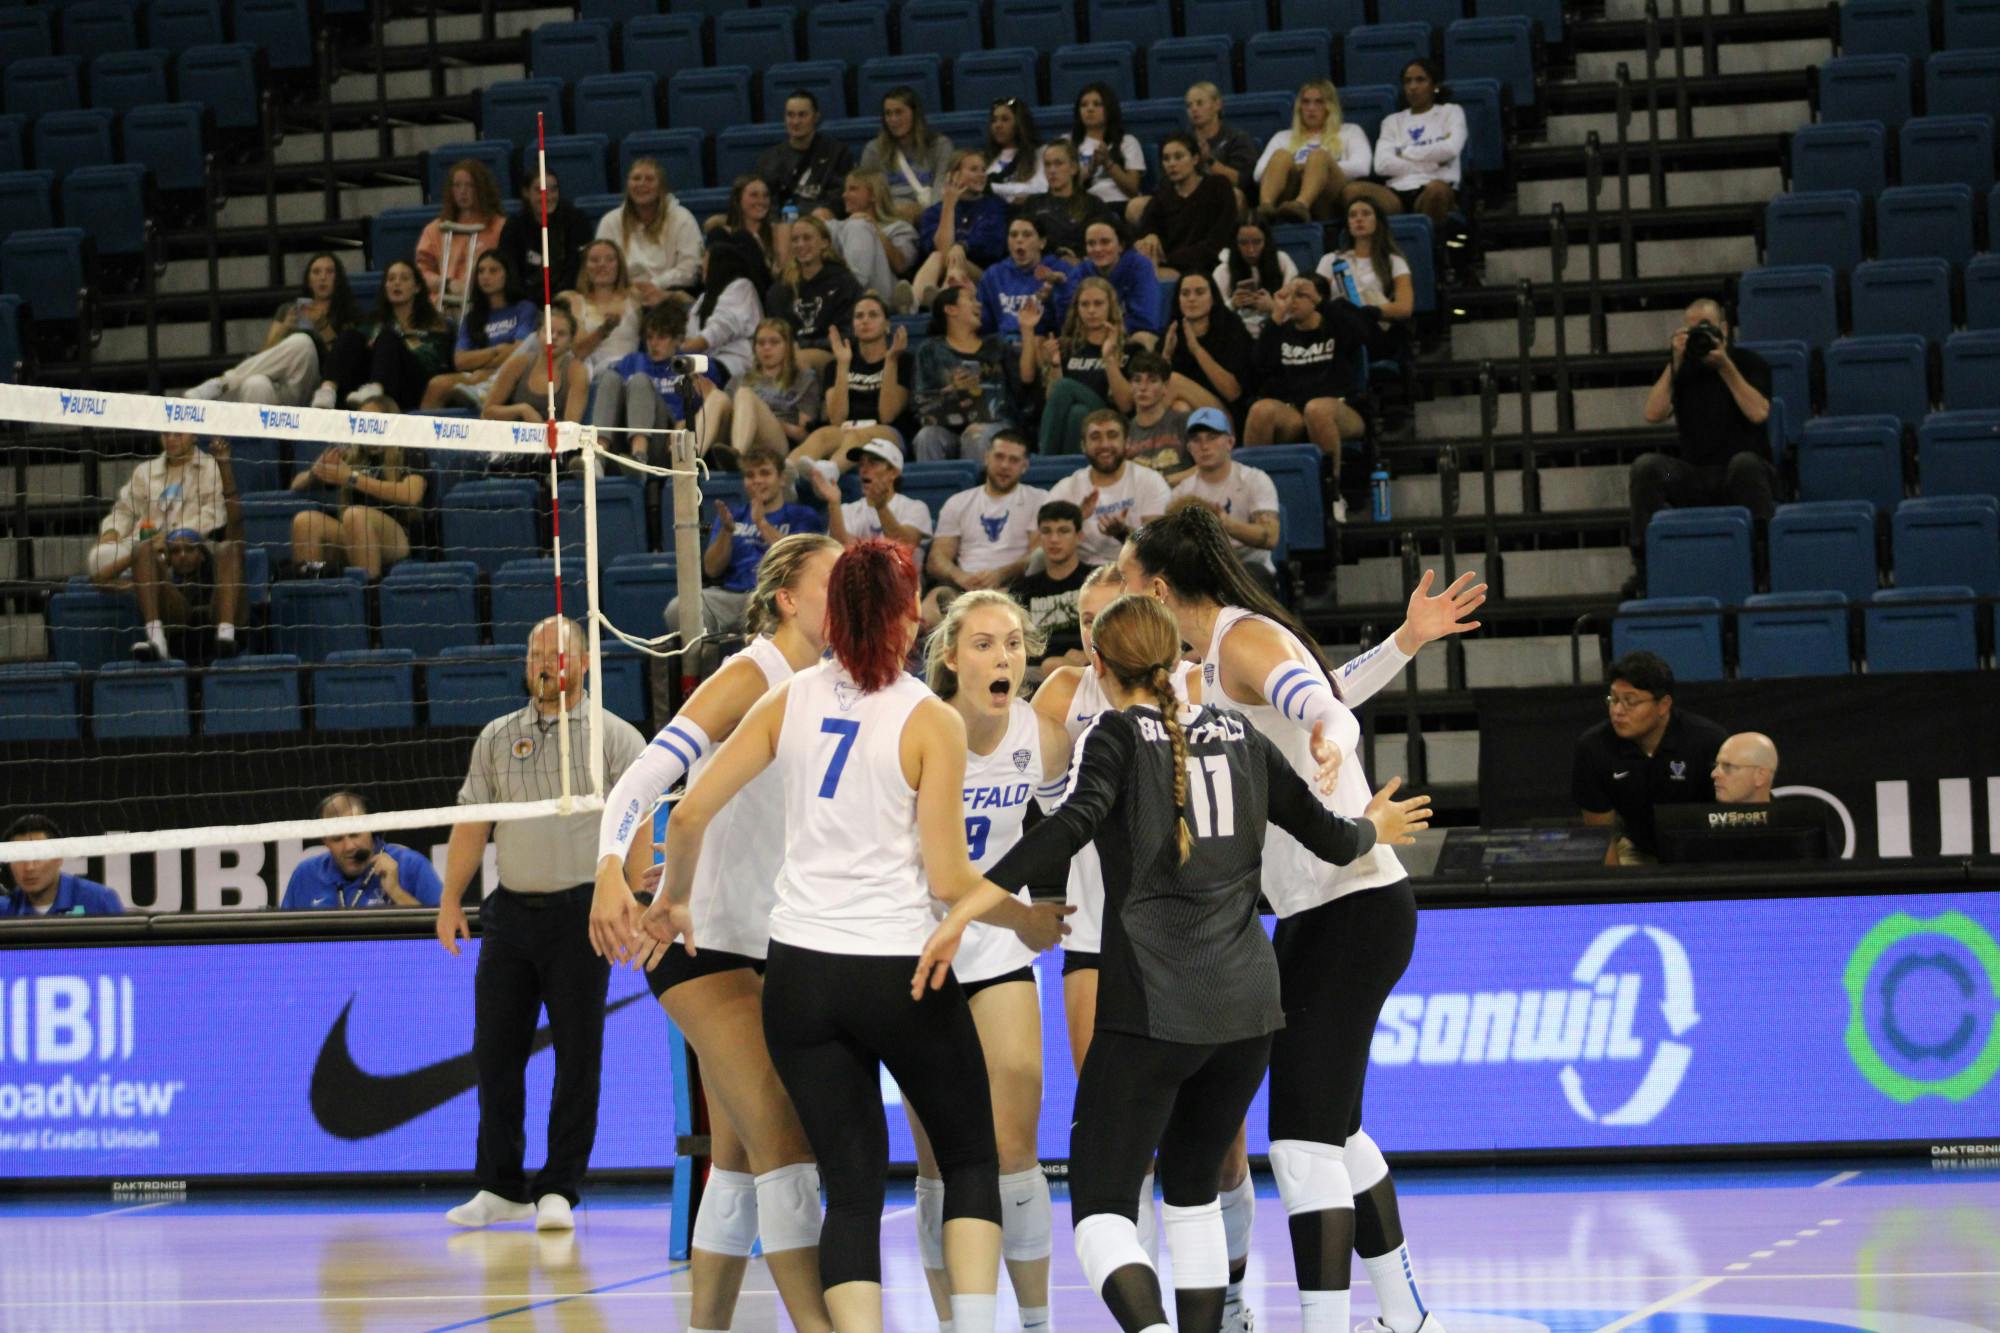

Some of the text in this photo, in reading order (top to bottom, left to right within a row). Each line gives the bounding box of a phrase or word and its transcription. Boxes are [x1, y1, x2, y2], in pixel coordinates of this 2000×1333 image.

[70, 395, 107, 415] BUFFALO
[174, 404, 206, 422] BUFFALO
[269, 411, 300, 429] BUFFALO
[357, 418, 389, 435] BUFFALO
[442, 423, 470, 440] BUFFALO
[818, 717, 861, 799] 7
[1185, 754, 1235, 838] 11
[0, 1073, 175, 1120] oadview
[1931, 1144, 2000, 1155] DAKTRONI
[112, 1181, 188, 1191] DAKTRONICS
